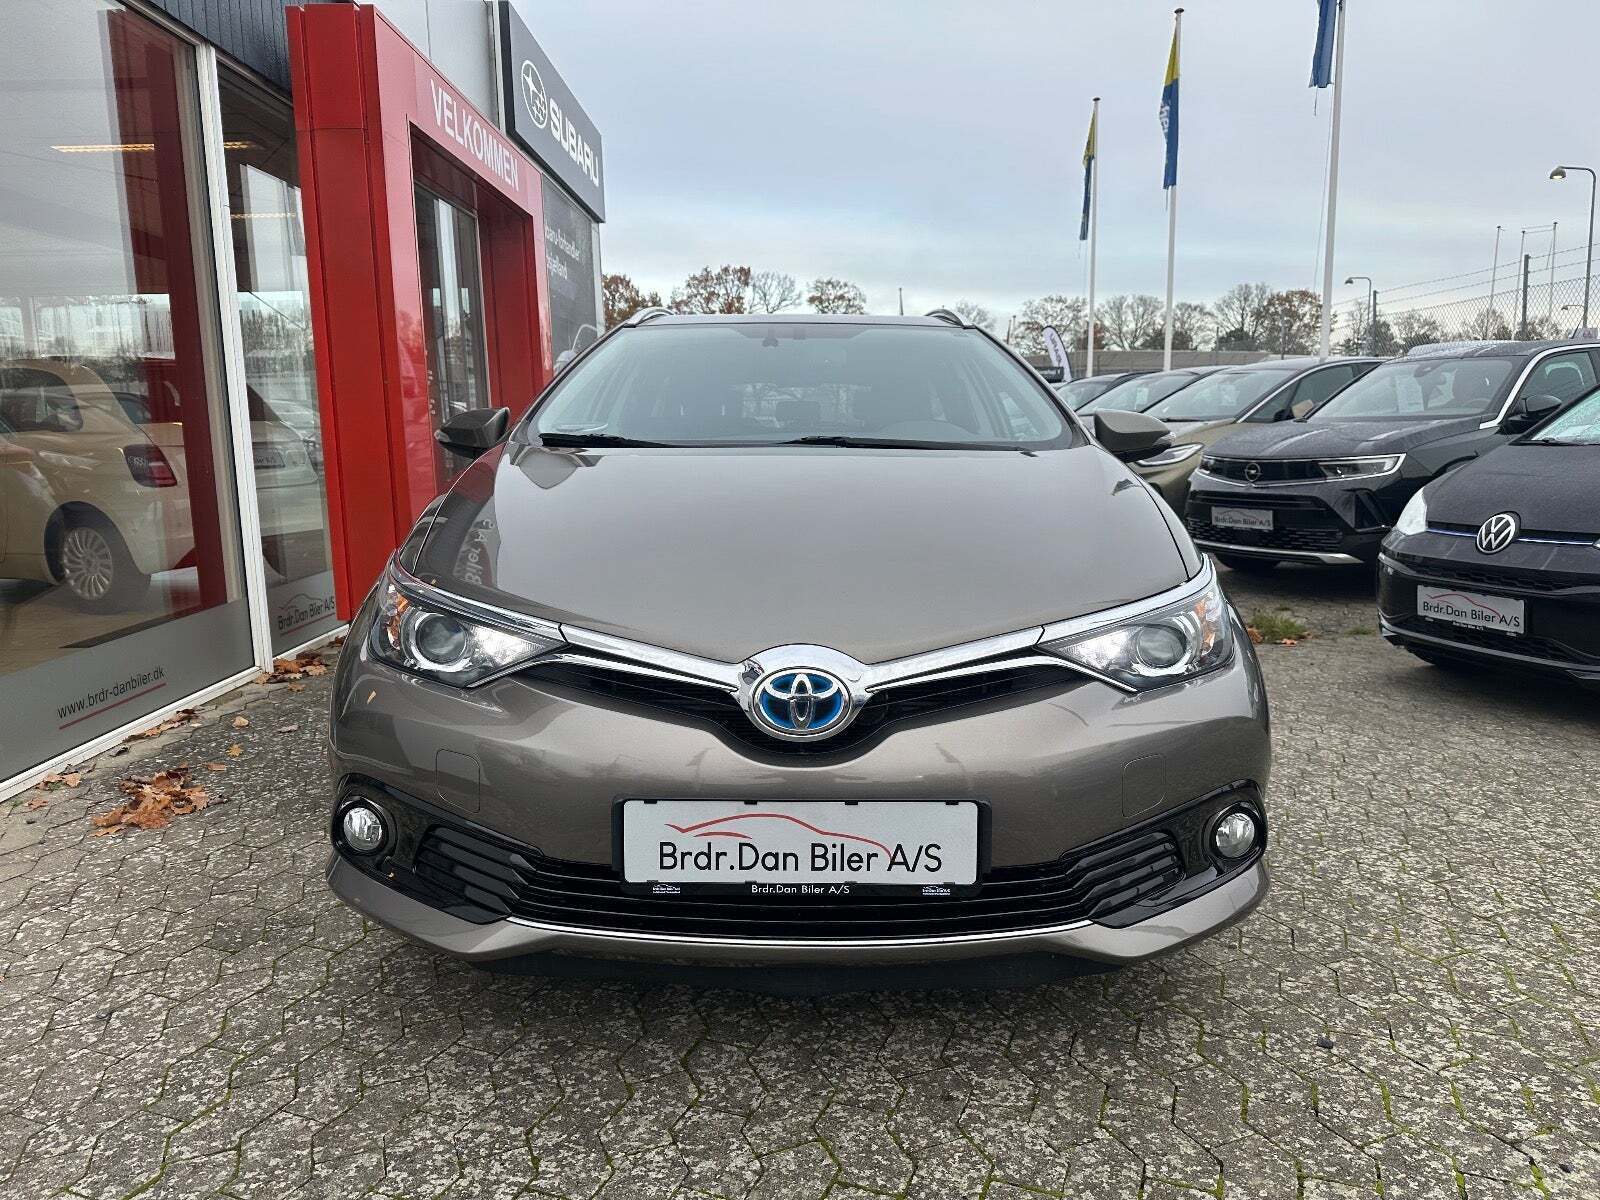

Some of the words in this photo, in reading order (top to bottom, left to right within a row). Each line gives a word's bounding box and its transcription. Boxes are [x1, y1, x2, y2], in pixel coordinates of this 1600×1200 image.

[431, 79, 519, 191] VELKOMMEN
[550, 98, 599, 187] SUBARU
[1423, 601, 1467, 618] Brdr.Dan
[1471, 609, 1496, 623] Biler
[1500, 614, 1520, 627] A/S
[58, 666, 164, 719] www.brdr-danbiler.dk
[659, 841, 799, 871] Brdr.Dan
[810, 842, 879, 872] Biler
[886, 843, 942, 873] A/S
[751, 883, 797, 894] Brdr.Dan
[801, 884, 825, 894] Biler
[828, 884, 850, 895] A/S
